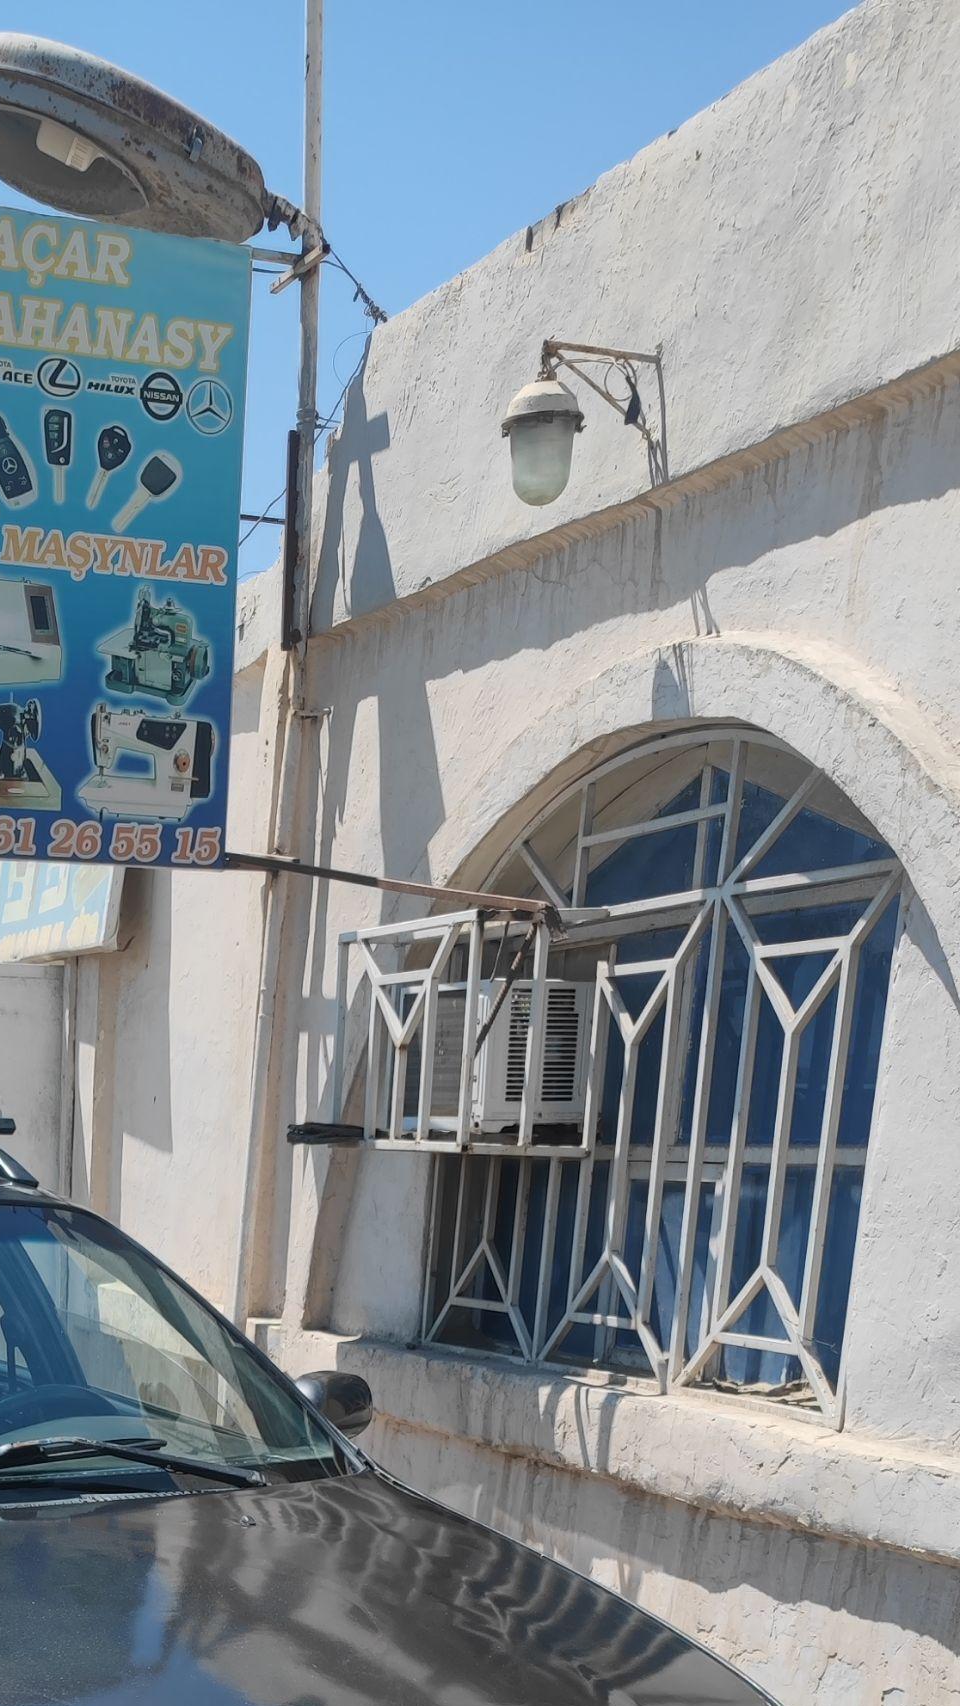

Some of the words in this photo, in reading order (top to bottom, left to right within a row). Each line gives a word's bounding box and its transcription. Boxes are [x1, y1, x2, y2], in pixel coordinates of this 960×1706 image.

[111, 375, 136, 385] TOYOTA
[87, 381, 135, 395] HILUX
[144, 390, 180, 402] NISSAN
[0, 524, 228, 583] MAŞYNLAR
[48, 819, 100, 860] 26
[109, 822, 161, 862] 55
[170, 826, 221, 864] 15
